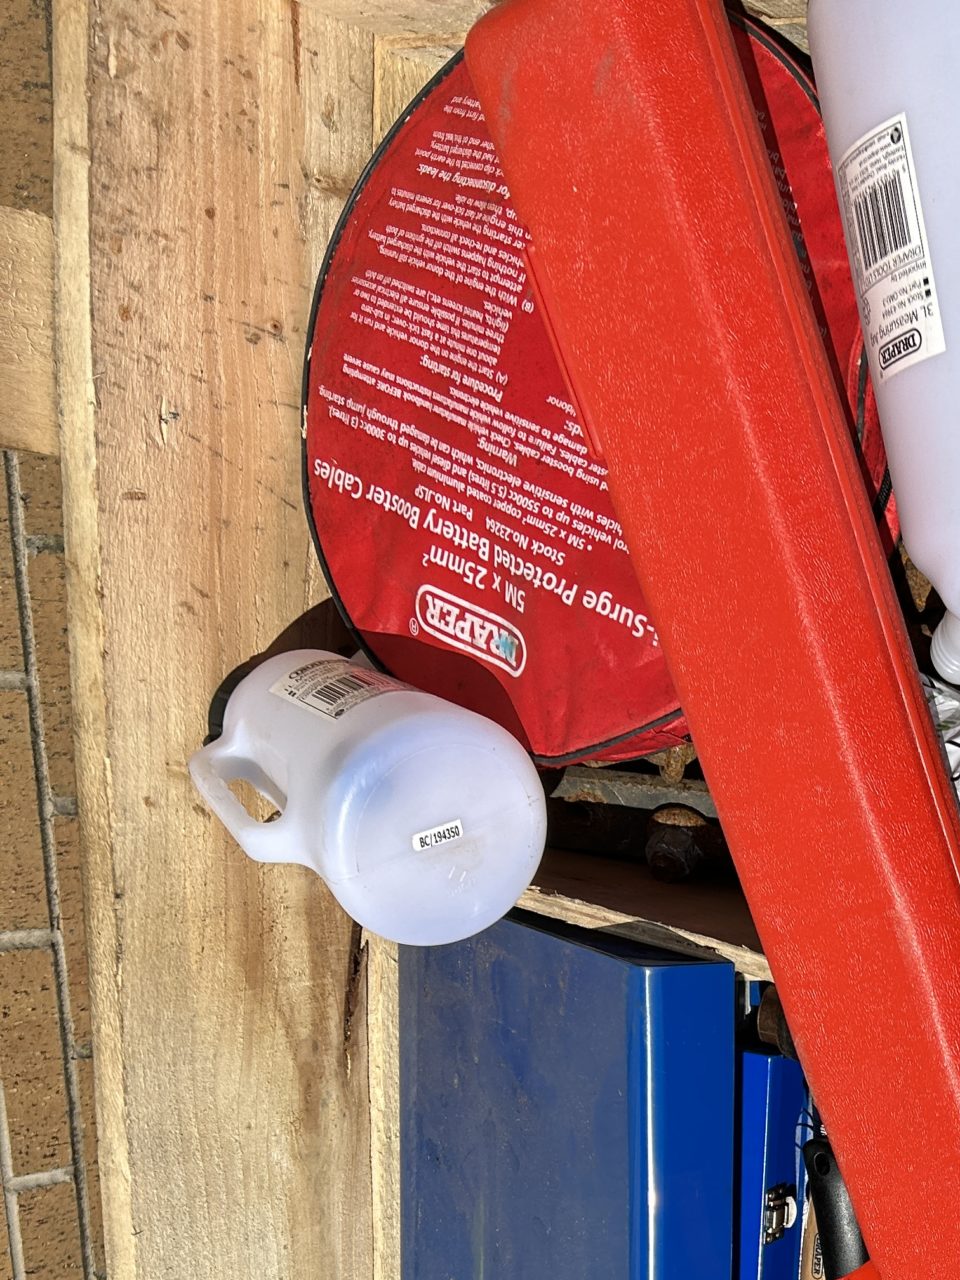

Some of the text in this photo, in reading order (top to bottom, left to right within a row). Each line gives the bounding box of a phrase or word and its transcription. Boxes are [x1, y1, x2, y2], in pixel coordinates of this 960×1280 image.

[920, 302, 934, 318] 3L
[875, 309, 920, 340] Measuring
[408, 335, 429, 350] donor
[878, 333, 921, 364] DRAPER
[450, 370, 462, 385] for
[478, 364, 495, 379] Start
[461, 374, 504, 402] Procedure
[345, 397, 367, 417] jump
[366, 407, 399, 431] through
[491, 418, 516, 437] follow
[504, 411, 540, 433] sensitive
[386, 432, 397, 445] to
[397, 436, 409, 448] up
[399, 422, 431, 445] damaged
[429, 437, 438, 450] be
[489, 430, 511, 447] Check
[517, 430, 527, 441] to
[540, 428, 552, 439] to
[552, 432, 588, 455] damage
[437, 441, 451, 454] can
[475, 434, 523, 467] Warning:
[527, 434, 557, 455] Failure
[450, 448, 474, 465] which
[540, 454, 574, 476] booster
[312, 458, 364, 499] Cables
[424, 467, 465, 492] aluminium
[451, 464, 467, 478] and
[575, 468, 600, 487] using
[466, 485, 493, 505] coated
[505, 490, 541, 513] 5500cc
[522, 481, 569, 508] sensitive
[364, 484, 422, 529] Booster
[451, 500, 474, 521] Part
[492, 498, 522, 518] copper
[541, 506, 554, 519] to
[569, 503, 594, 521] with
[555, 510, 571, 524] up
[422, 508, 497, 561] Battery
[558, 529, 567, 539] x
[567, 533, 586, 550] 5M
[571, 520, 612, 545] vehicles
[530, 540, 566, 565] Stock
[612, 538, 630, 554] rol
[484, 545, 579, 606] Protected
[490, 573, 502, 592] x
[502, 581, 527, 613] 5M
[419, 825, 460, 849] BC/194350
